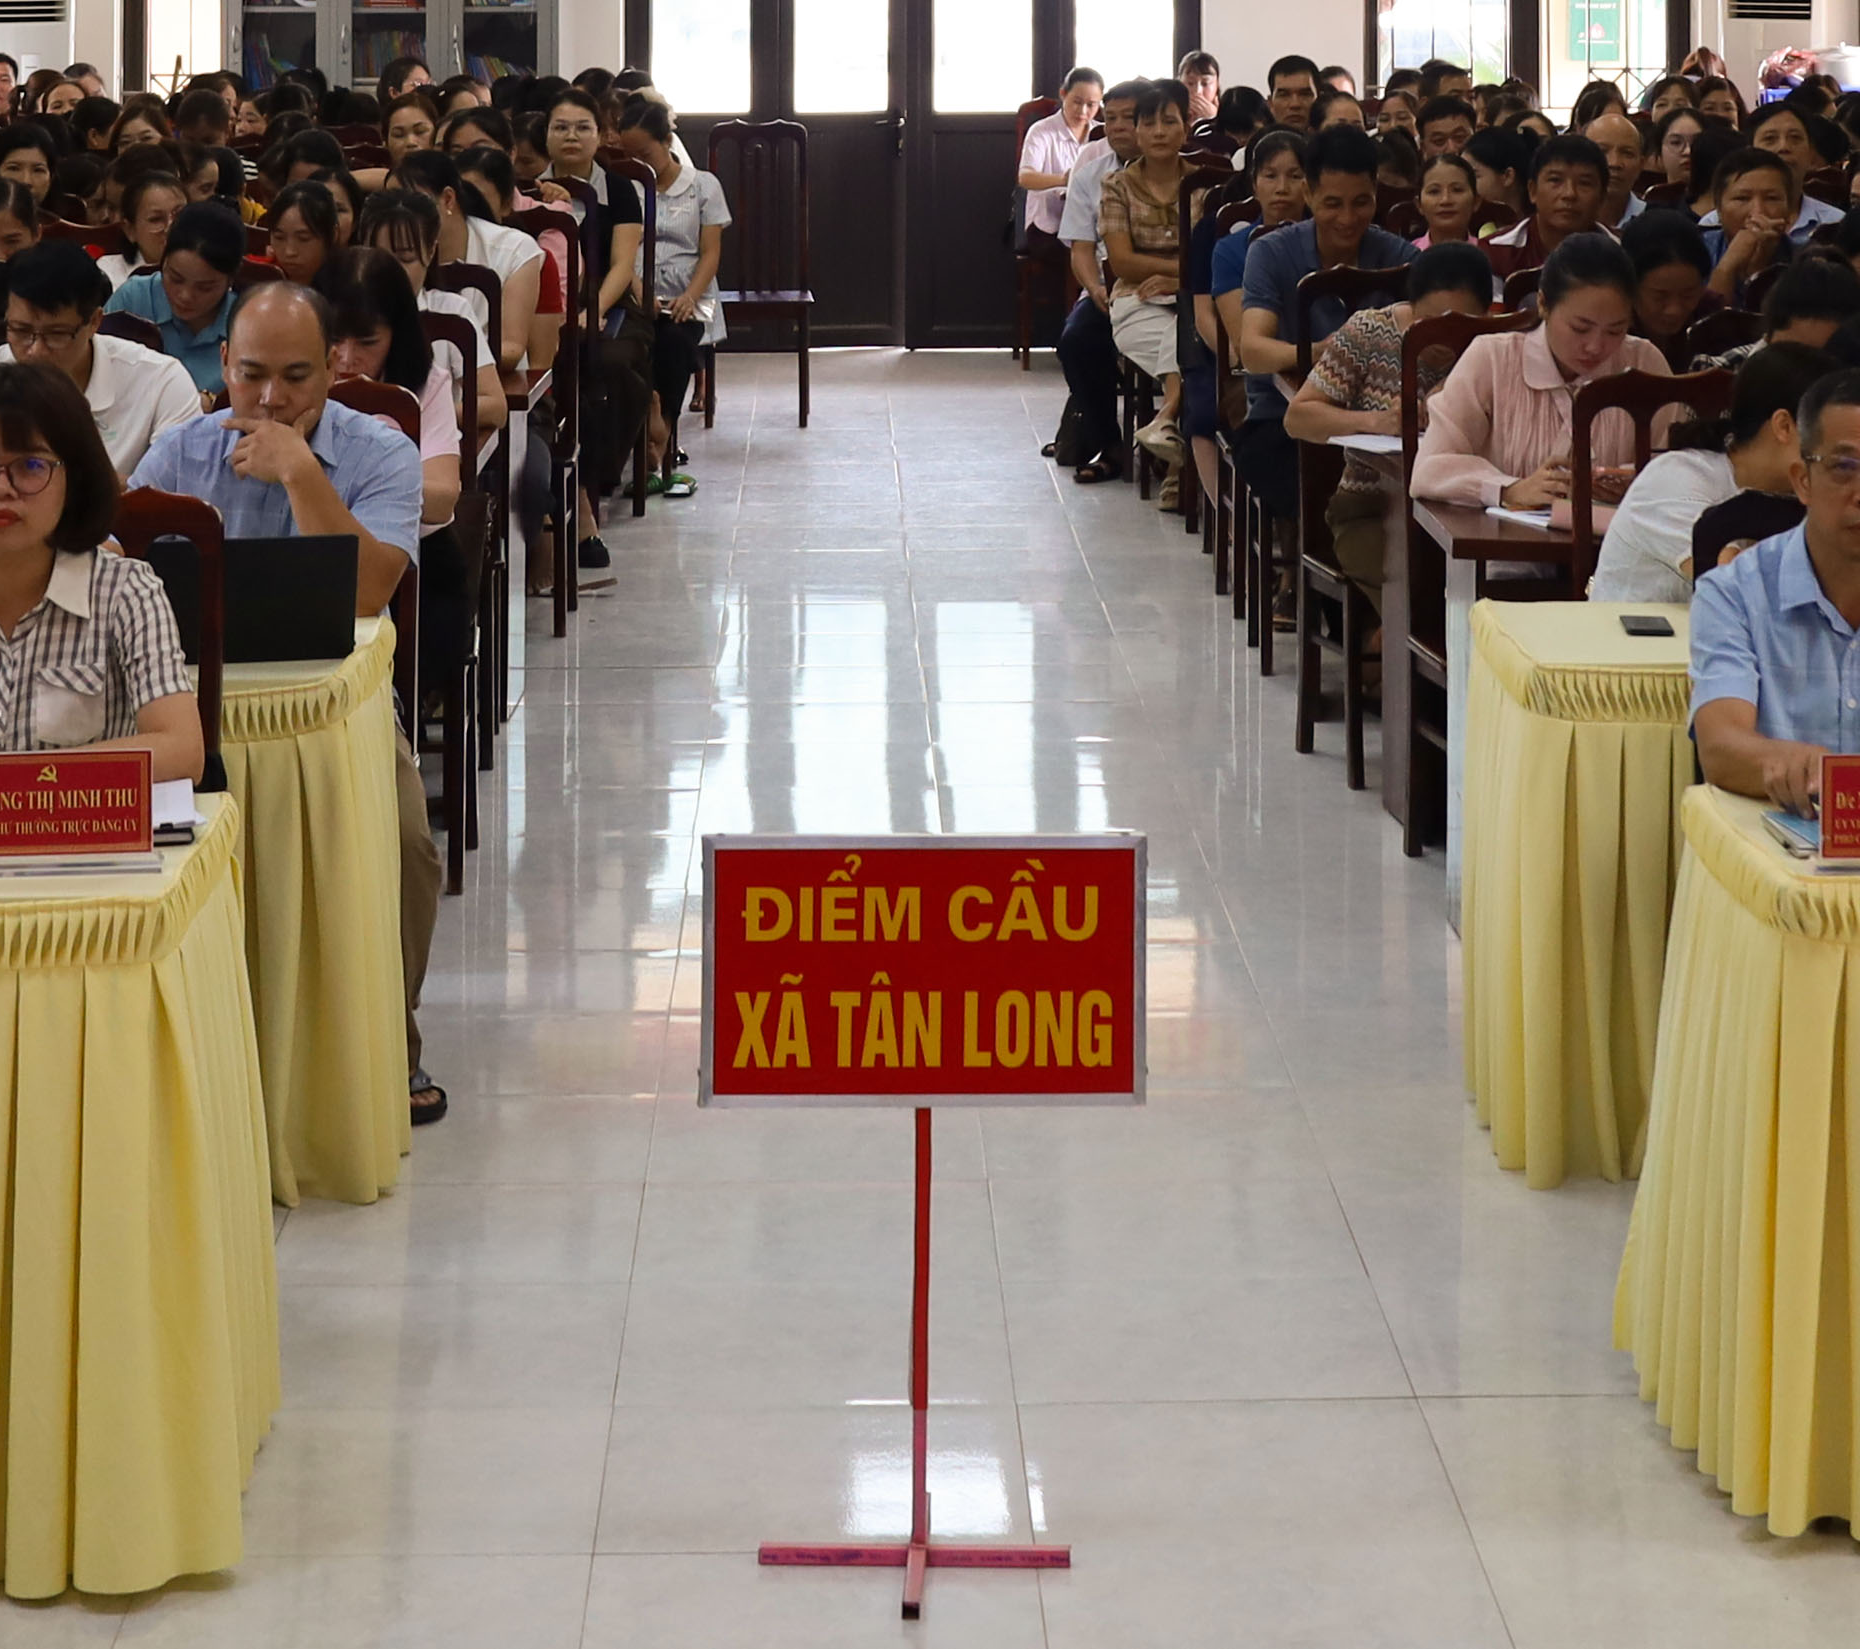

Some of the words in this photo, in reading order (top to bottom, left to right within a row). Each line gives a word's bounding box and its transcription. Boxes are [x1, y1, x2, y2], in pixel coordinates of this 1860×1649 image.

[15, 816, 59, 835] THƯỜNG
[62, 819, 90, 836] TRỰC
[92, 817, 121, 832] ĐẢNG
[26, 791, 53, 814] THỊ
[58, 789, 101, 808] MINH
[105, 788, 138, 808] THU
[741, 854, 921, 941] ĐIỂM
[947, 859, 1100, 941] CẦU
[732, 973, 811, 1068] XÃ
[830, 971, 941, 1068] TÂN
[963, 989, 1114, 1068] LONG
